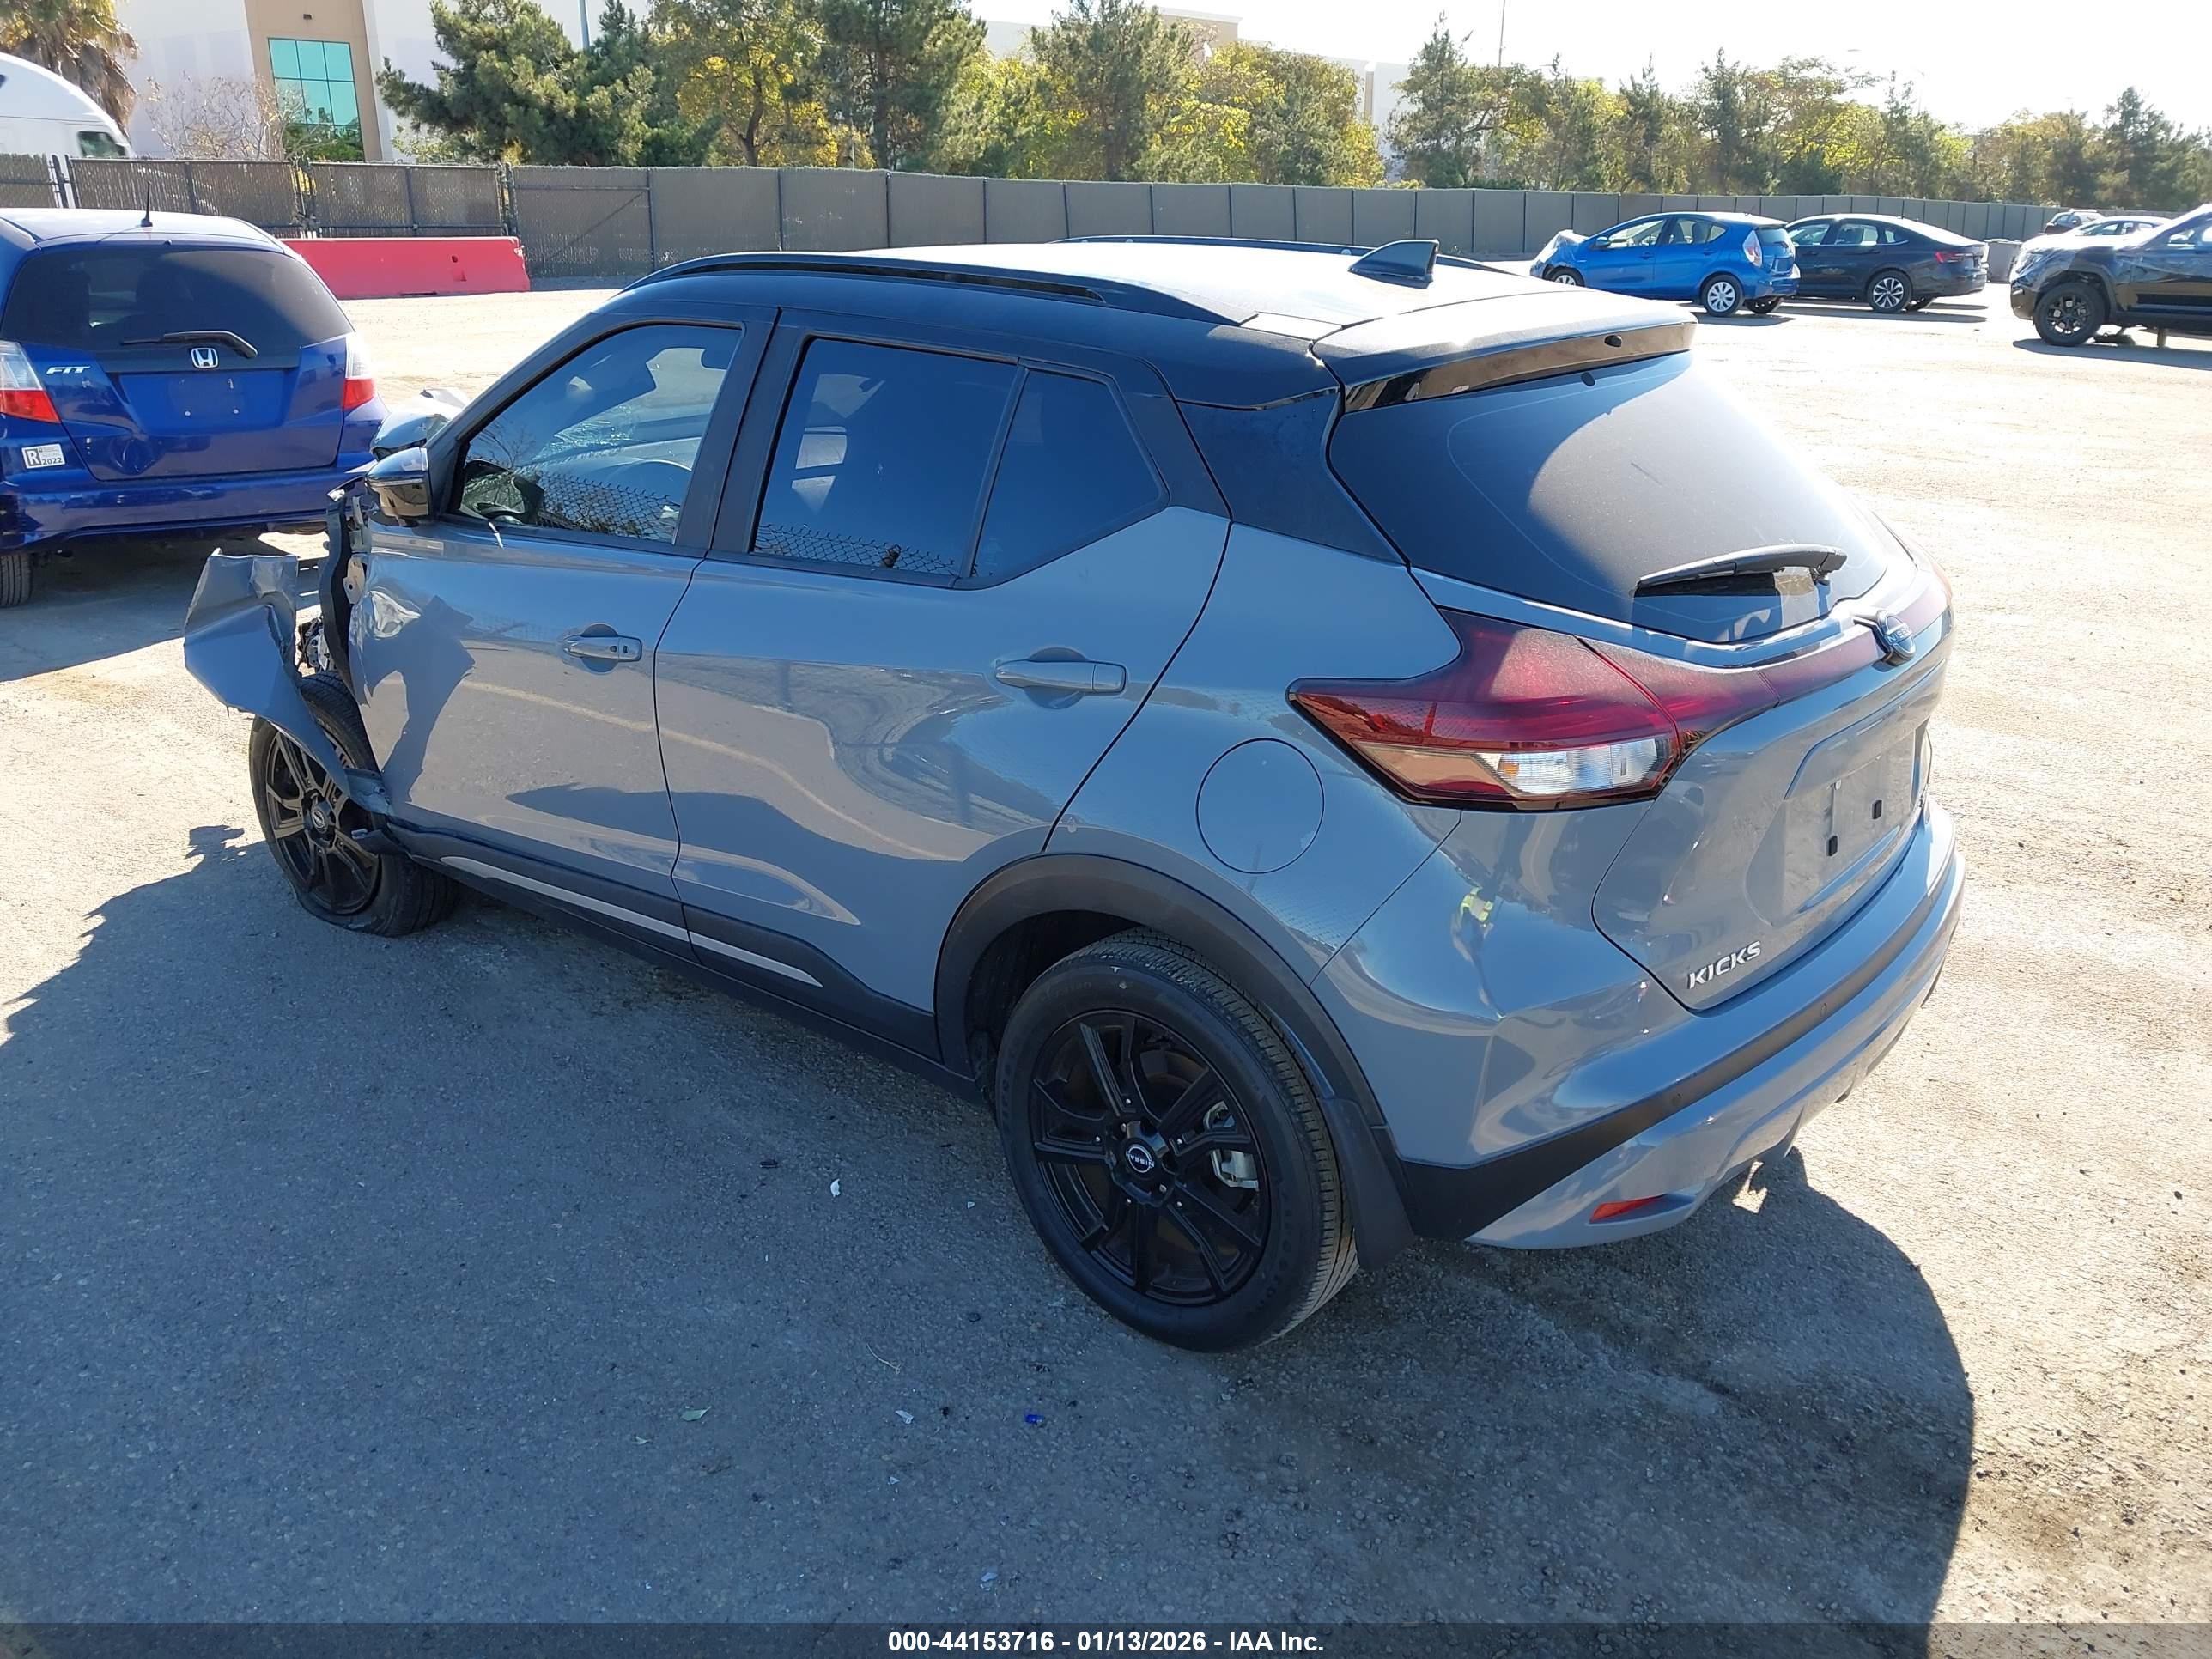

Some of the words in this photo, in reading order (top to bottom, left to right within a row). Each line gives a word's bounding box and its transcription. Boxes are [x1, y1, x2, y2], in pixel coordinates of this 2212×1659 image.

[46, 365, 91, 374] FIT
[41, 457, 64, 465] 2022
[1688, 940, 1761, 990] KICKS
